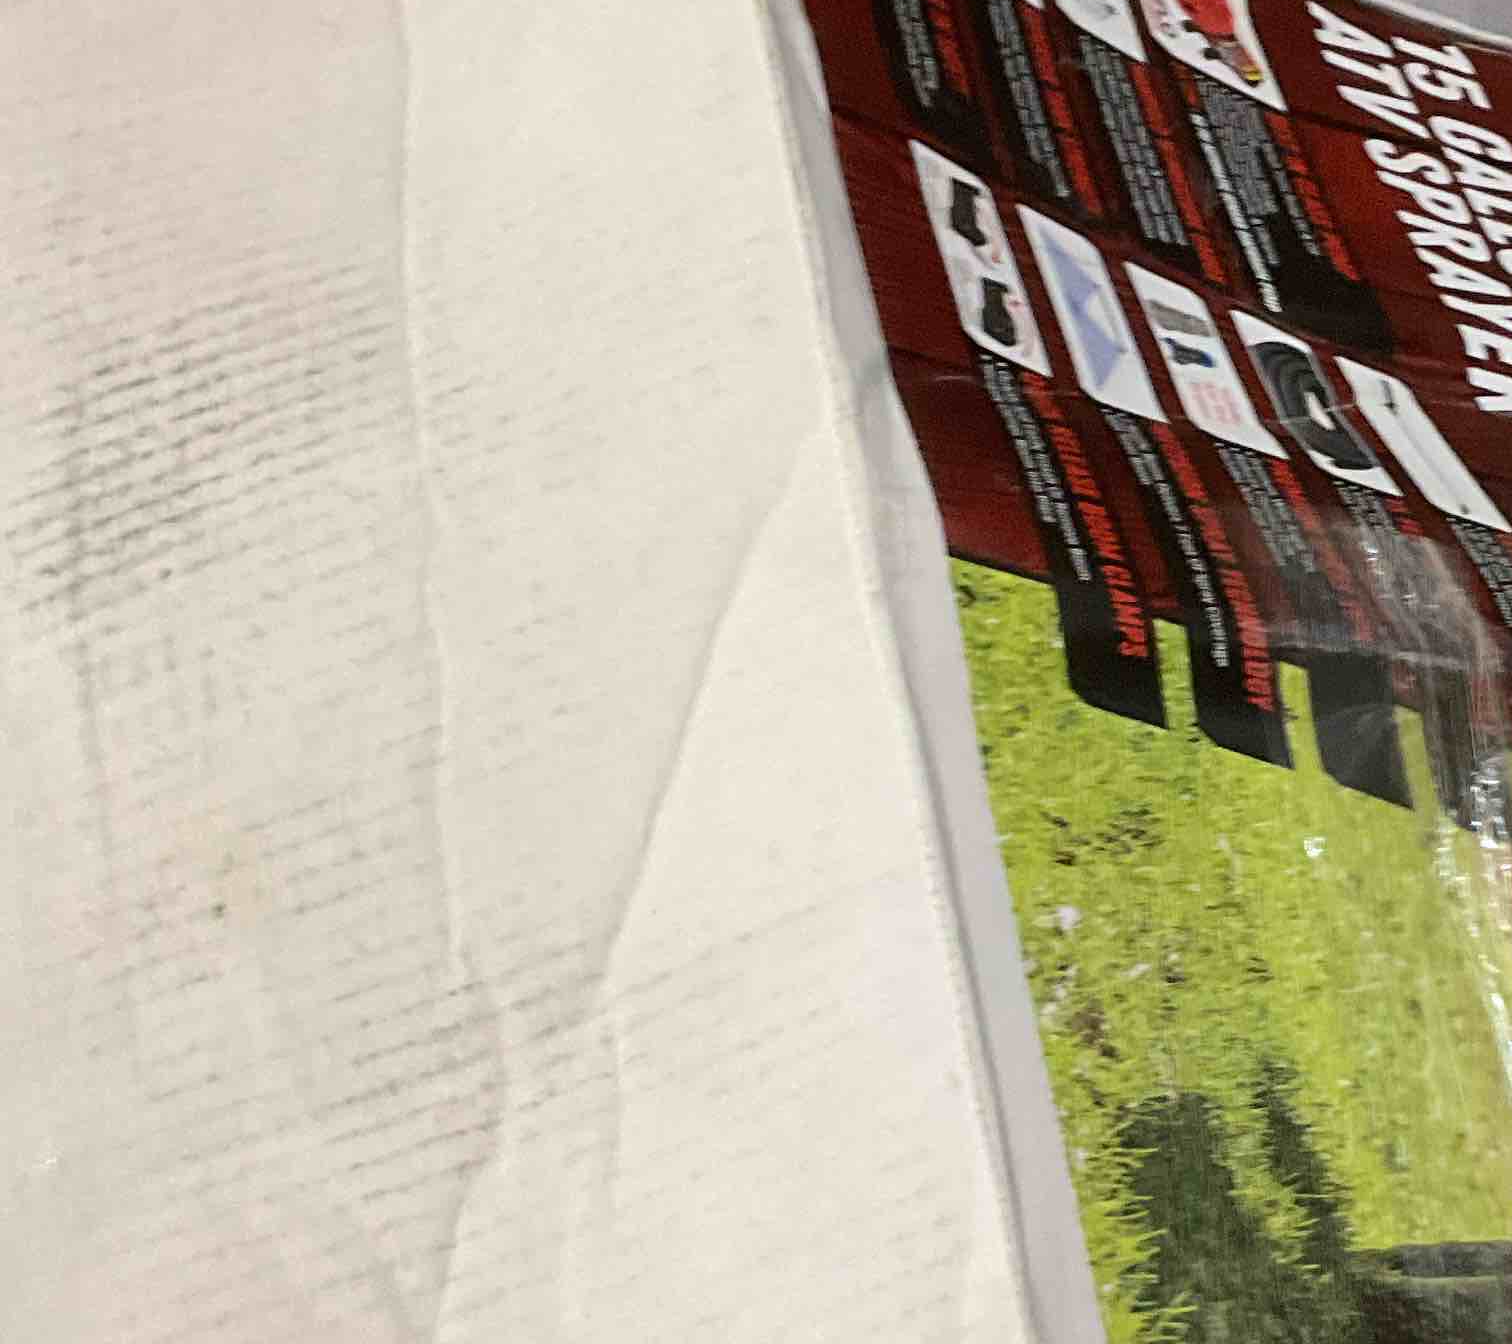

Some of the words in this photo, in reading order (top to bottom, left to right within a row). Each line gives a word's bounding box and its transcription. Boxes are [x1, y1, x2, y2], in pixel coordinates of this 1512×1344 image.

[1305, 0, 1425, 151] ATV
[1388, 34, 1494, 112] 15
[1101, 563, 1149, 657] CLAMPS
